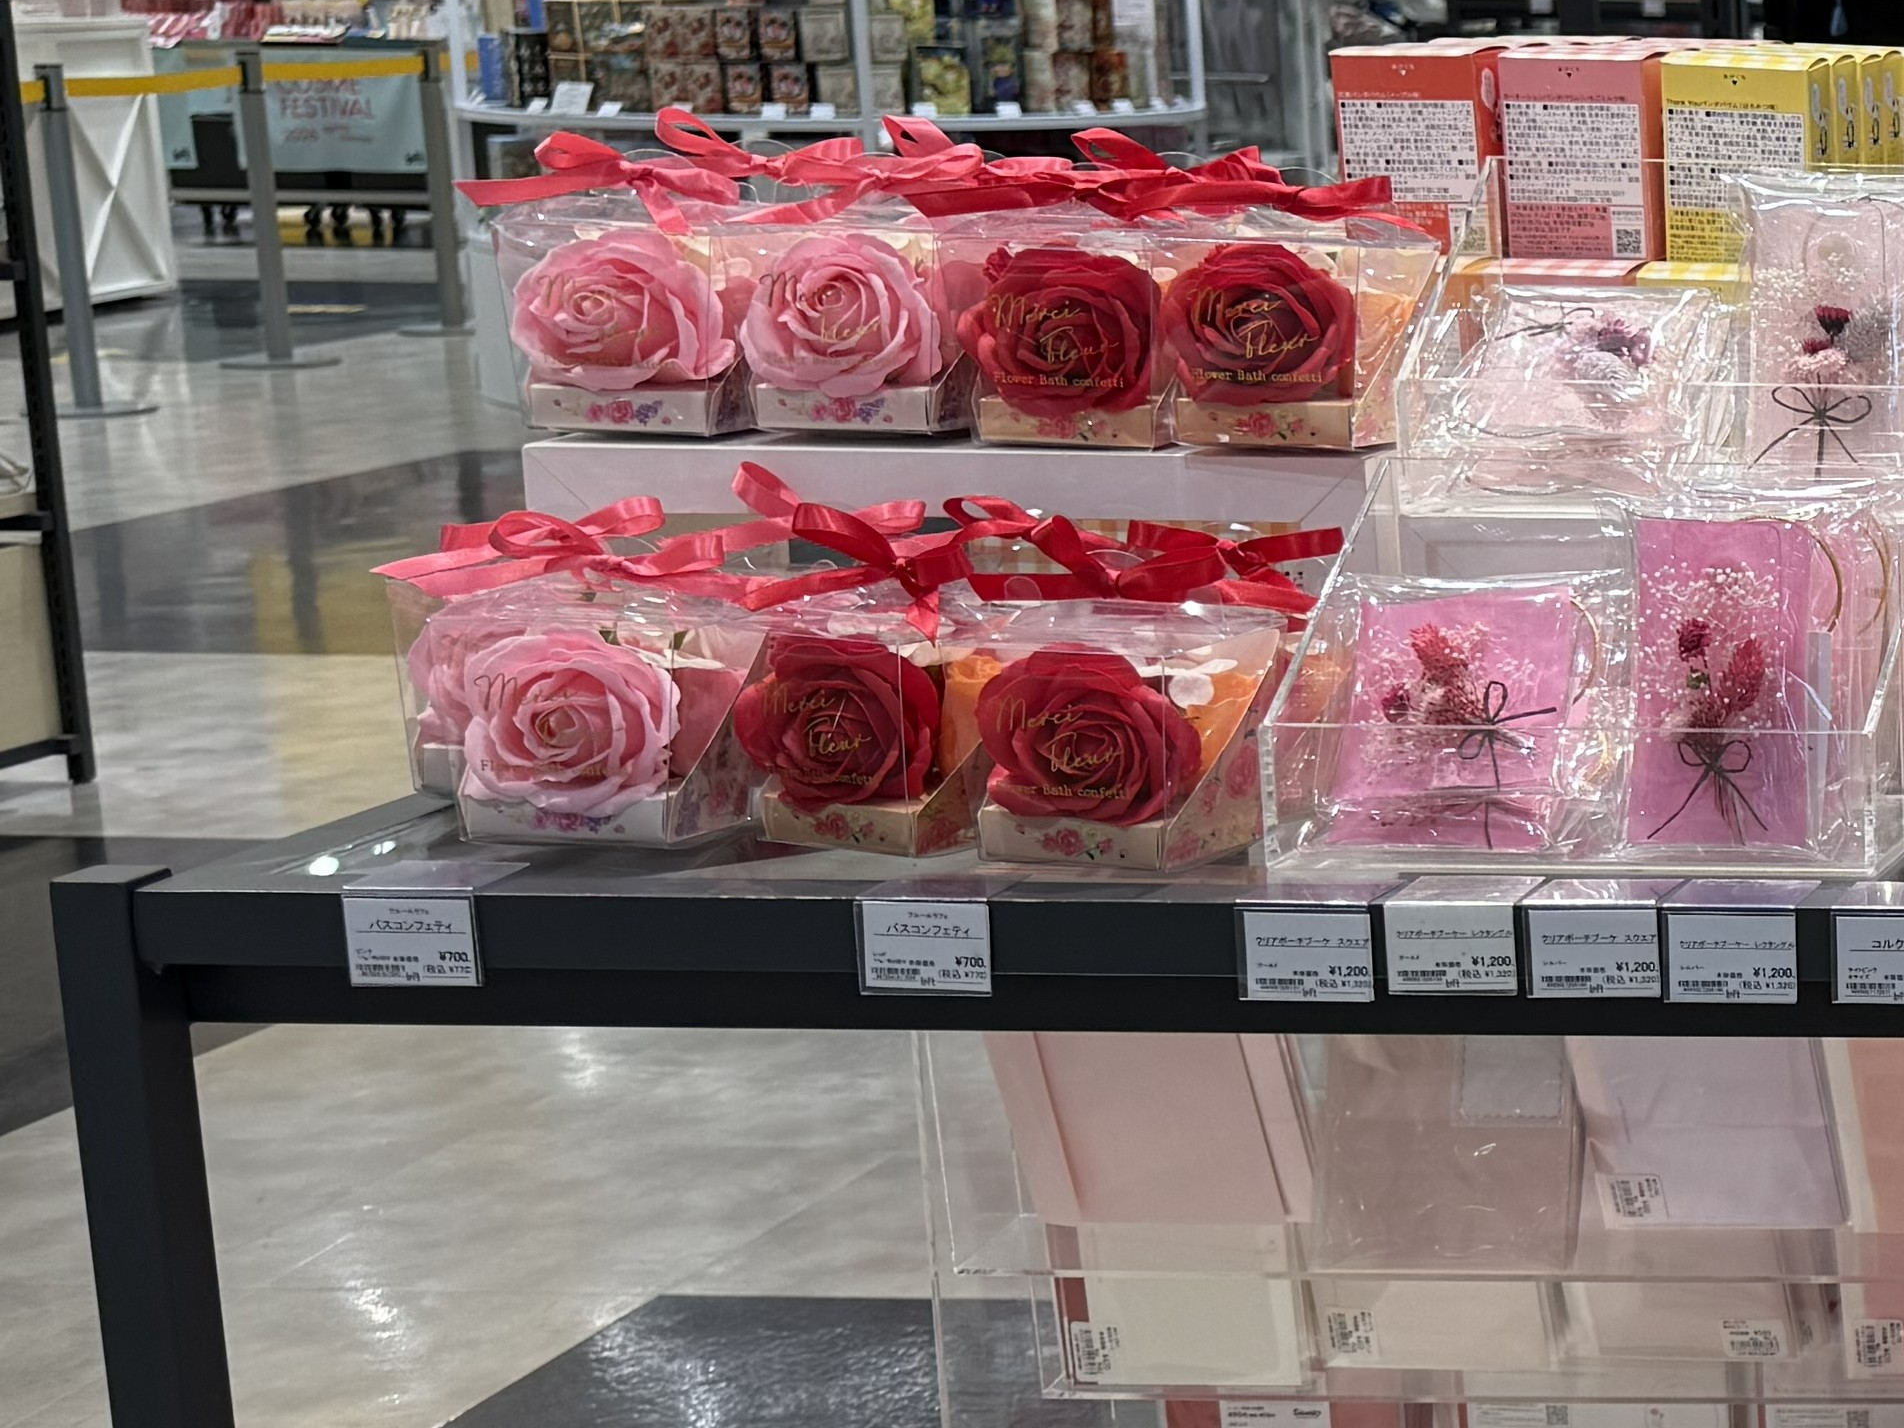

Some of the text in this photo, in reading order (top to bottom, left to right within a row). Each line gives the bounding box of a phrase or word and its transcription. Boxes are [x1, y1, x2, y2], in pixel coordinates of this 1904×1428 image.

[370, 920, 453, 932] バスコンフェティ
[887, 923, 971, 938] バスコンフェティ
